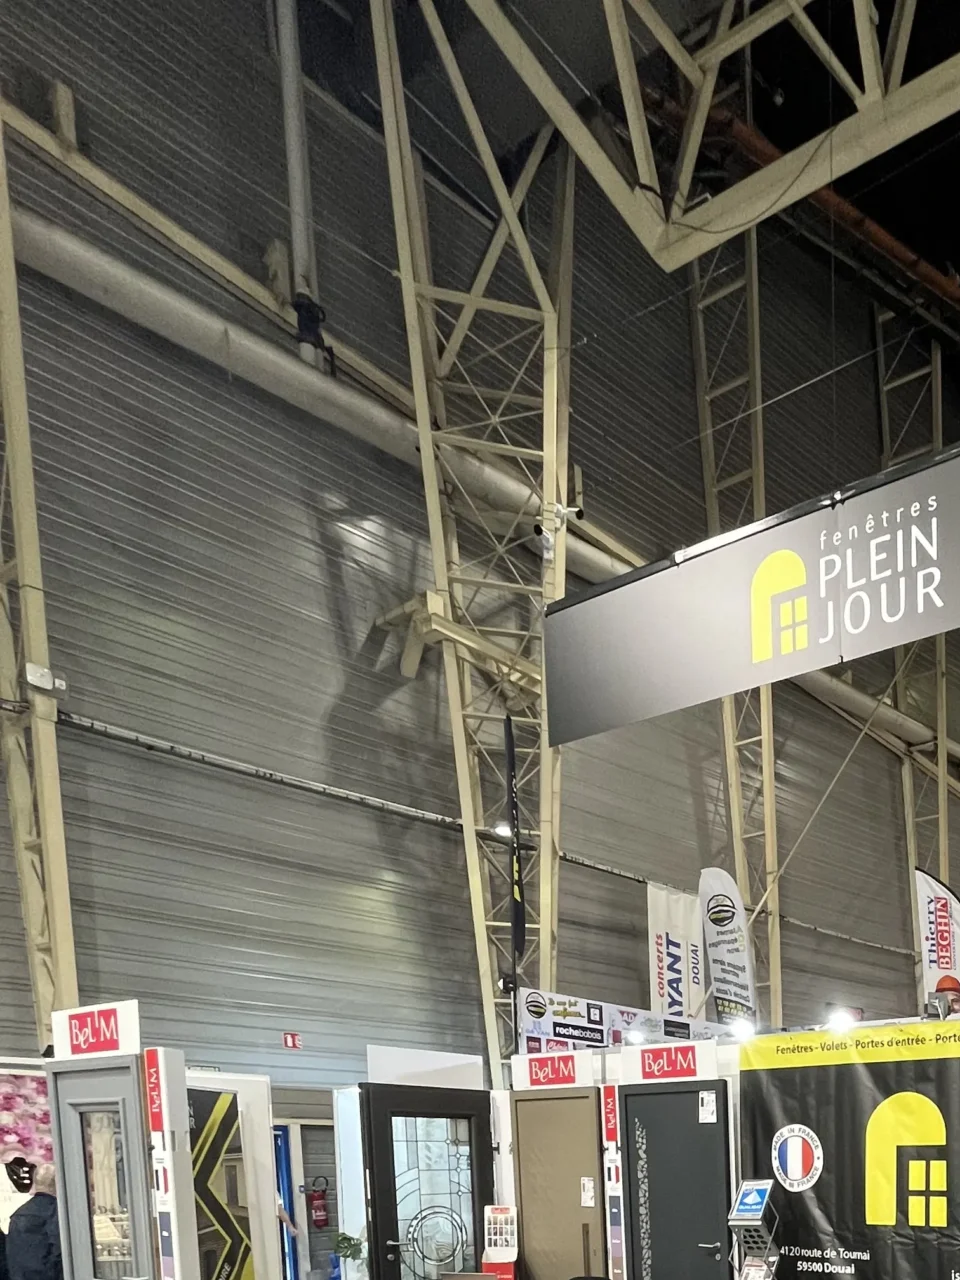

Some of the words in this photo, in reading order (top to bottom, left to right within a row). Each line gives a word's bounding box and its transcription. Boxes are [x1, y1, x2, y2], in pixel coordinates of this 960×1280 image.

[820, 495, 938, 549] fenêtres
[819, 516, 939, 598] PLEIN
[819, 566, 945, 645] JOUR
[925, 896, 937, 969] Thierry
[936, 898, 951, 968] BEGHIN
[656, 933, 665, 998] concerts
[690, 943, 700, 985] DOUAI
[622, 1012, 635, 1021] AD
[820, 1041, 847, 1052] Volets
[855, 1038, 885, 1050] Portes
[887, 1035, 926, 1047] d'entrée
[773, 1132, 785, 1151] MADE
[798, 1128, 820, 1150] FRANCE
[797, 1166, 819, 1188] FRANCE
[780, 1246, 800, 1256] 4120
[801, 1248, 822, 1258] route
[824, 1247, 836, 1258] de
[797, 1261, 823, 1272] 59500
[825, 1262, 855, 1274] Douai
